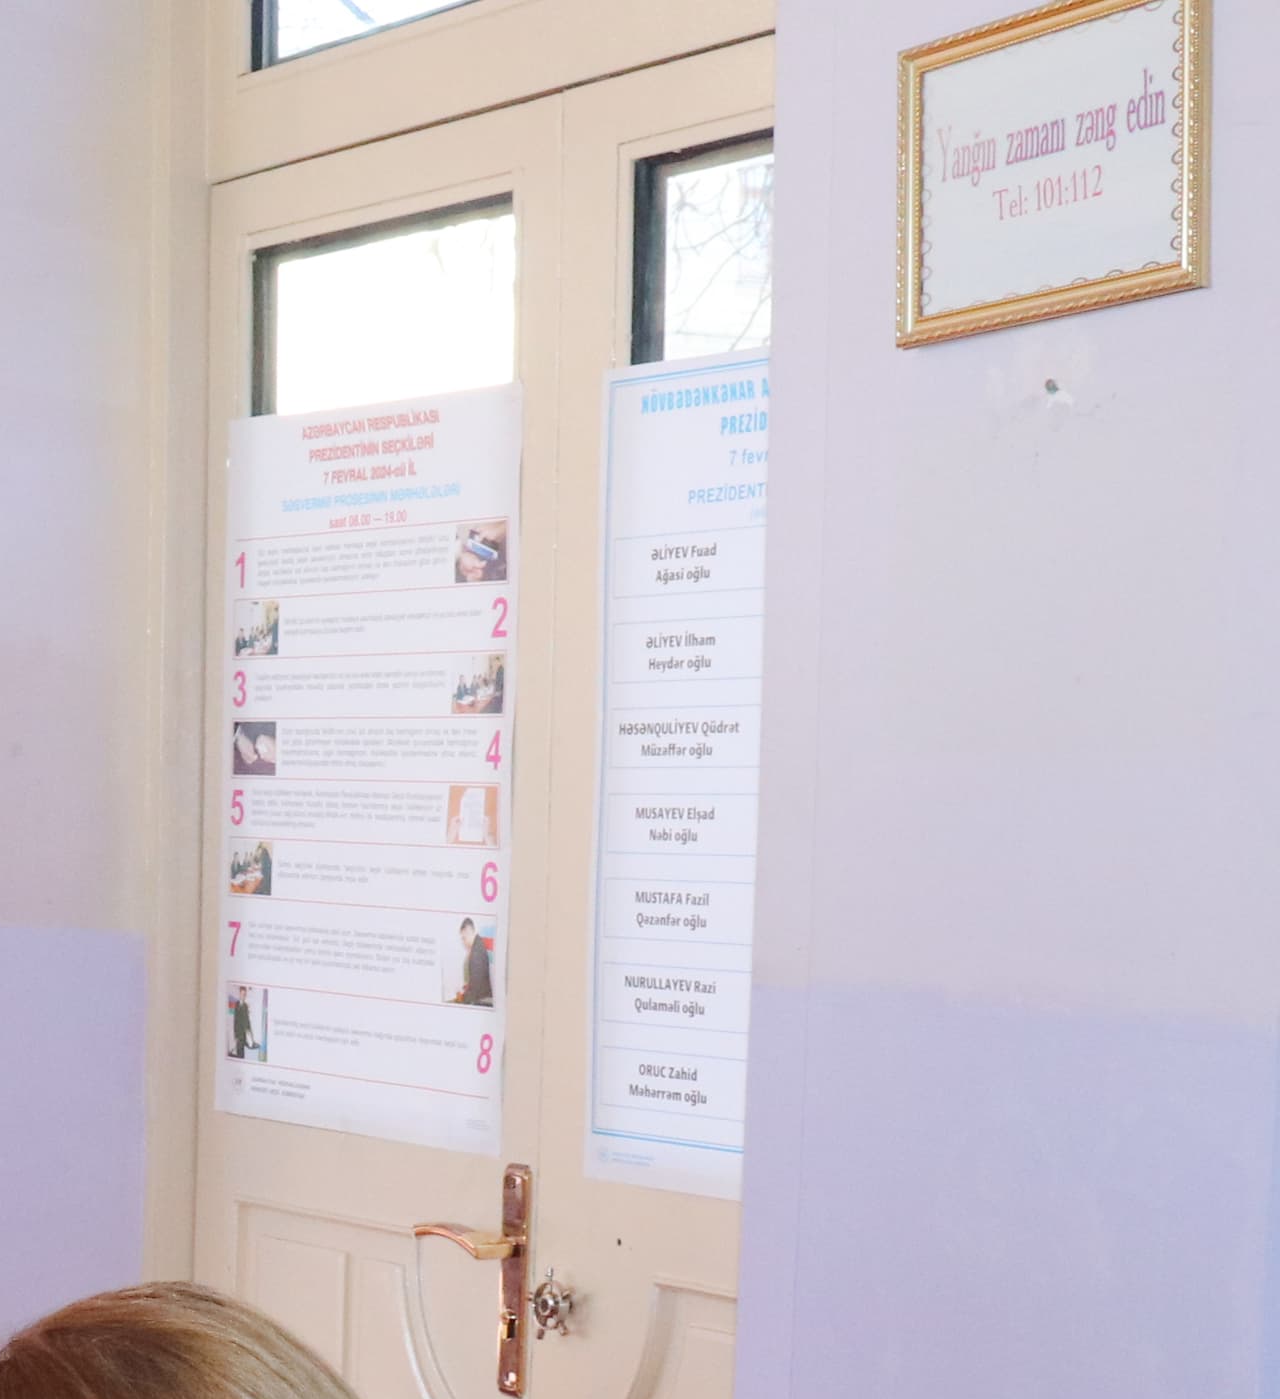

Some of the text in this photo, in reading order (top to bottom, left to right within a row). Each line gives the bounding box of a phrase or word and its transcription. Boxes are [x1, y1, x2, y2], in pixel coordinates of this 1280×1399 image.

[1006, 117, 1066, 166] zamanı
[1075, 102, 1118, 152] zəng
[1126, 68, 1166, 133] edin
[993, 184, 1029, 221] Tel:
[641, 380, 754, 414] NÖVBƏDƏNKƏNAR
[302, 408, 440, 440] AZƏRBAYCAN RESPUBLİKASI
[729, 450, 737, 465] 7
[323, 472, 330, 485] 7
[331, 468, 368, 485] FEVRAL
[651, 542, 717, 561] ƏLİYEV Fuad
[235, 552, 246, 588] 1
[656, 565, 710, 584] Ağasi oğlu
[491, 597, 508, 638] 2
[646, 631, 716, 648] ƏLİYEV İlham
[648, 655, 712, 673] Heydər oğlu
[233, 671, 246, 708] 3
[619, 718, 739, 737] HƏSƏNQULİYEV Qüdrət
[486, 730, 502, 771] 4
[641, 742, 713, 759] Müzəffər oğlu
[230, 789, 244, 825] 5
[635, 806, 715, 823] MUSAYEV Elşad
[649, 828, 698, 845] Nəbi oğlu
[481, 862, 498, 902] 6
[635, 891, 709, 906] MUSTAFA Fazil
[636, 912, 707, 931] Qəzənfər oğlu
[228, 921, 241, 957] 7
[624, 976, 716, 994] NURULLAYEV Razi
[634, 998, 705, 1018] Qulaməli oğlu
[476, 1033, 493, 1074] 8
[639, 1064, 697, 1081] ORUC Zahid
[629, 1083, 707, 1106] Məhərrəm oğlu
